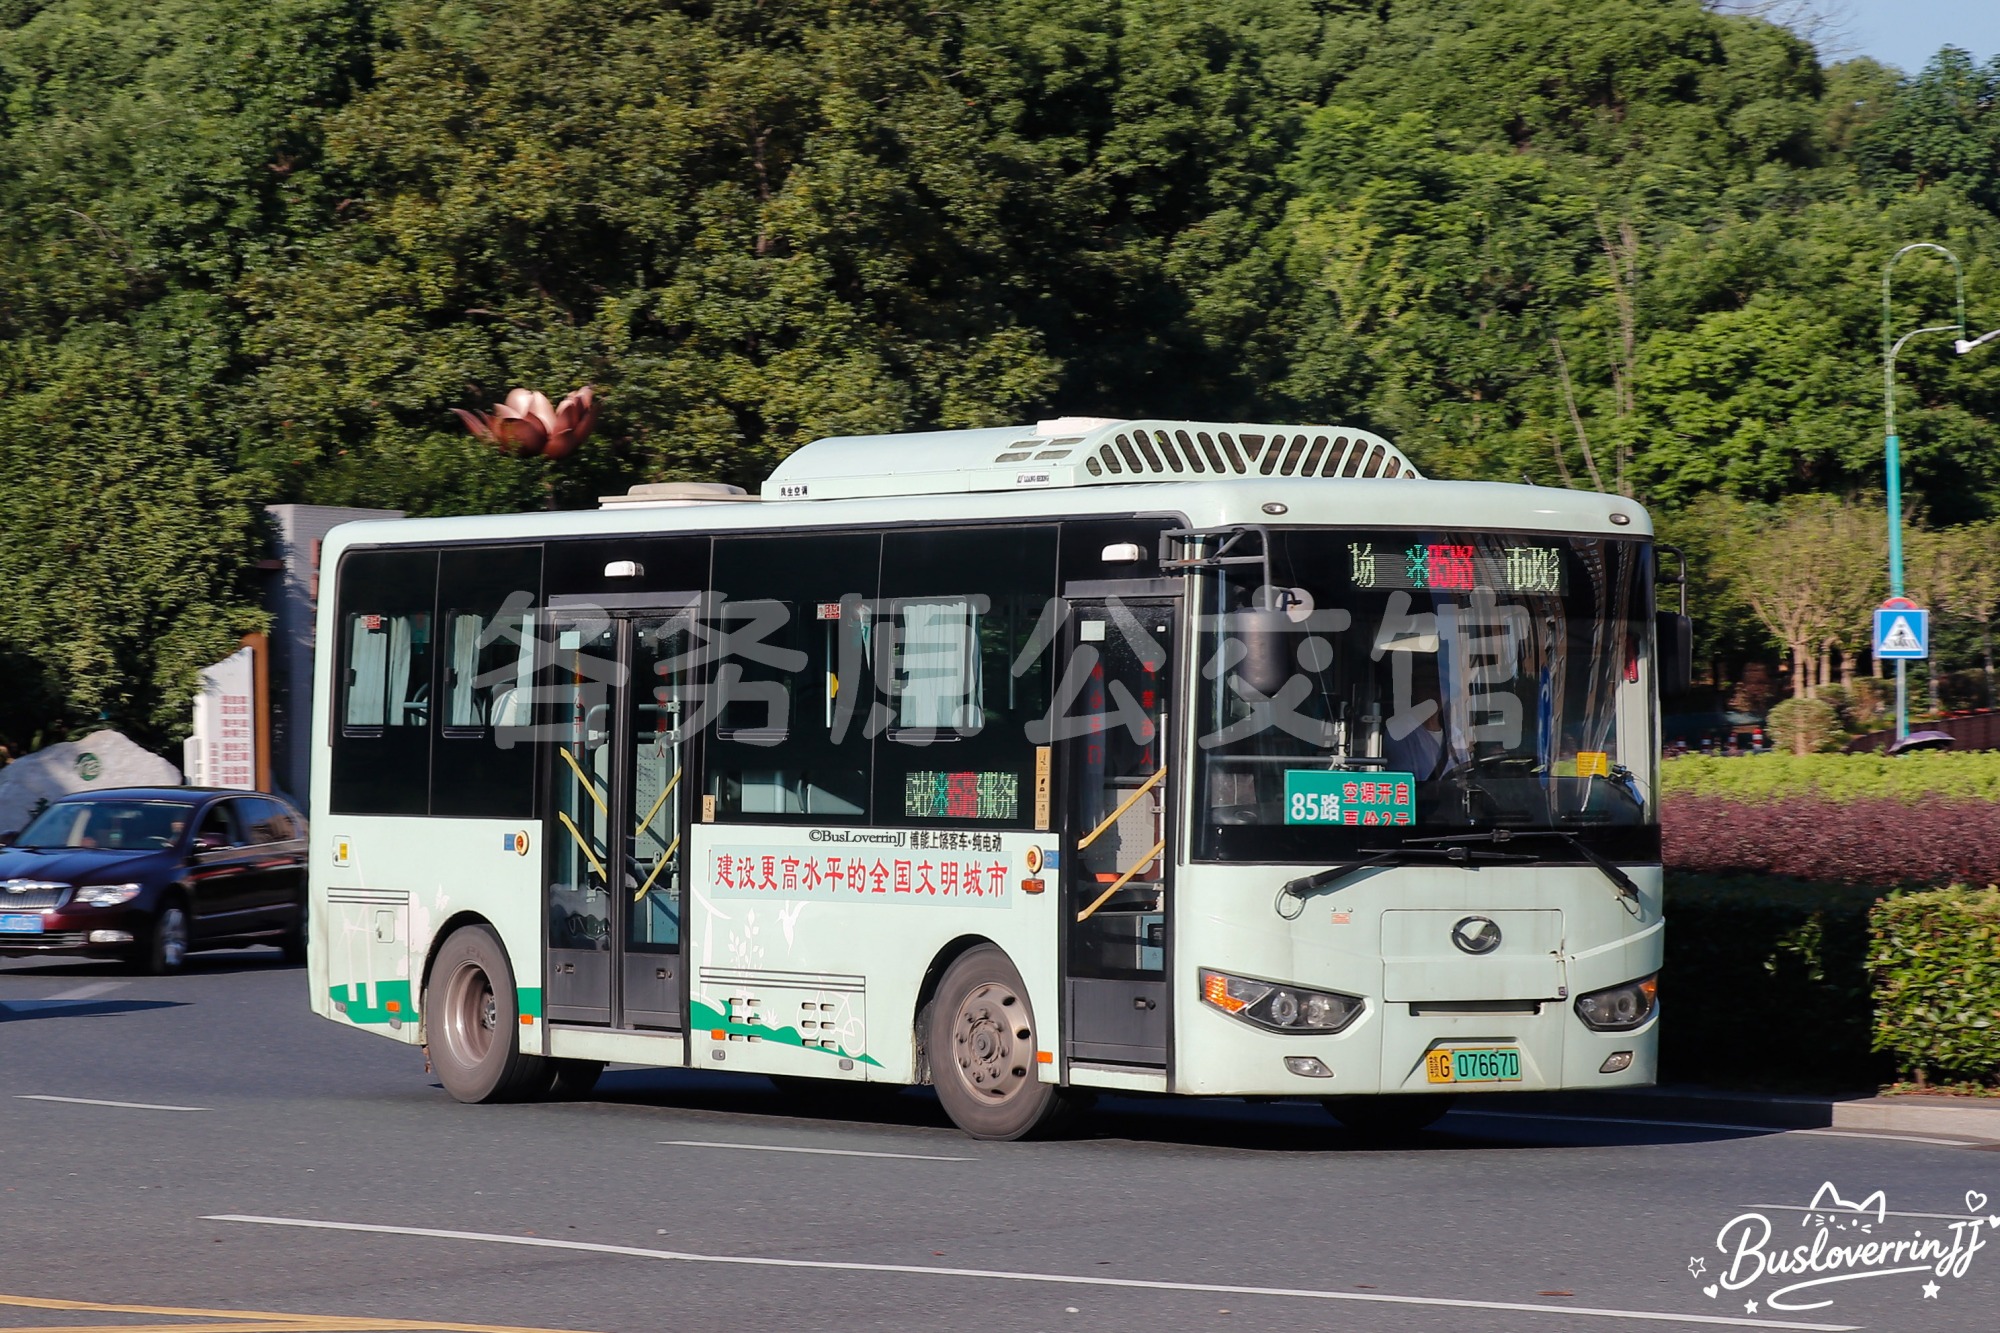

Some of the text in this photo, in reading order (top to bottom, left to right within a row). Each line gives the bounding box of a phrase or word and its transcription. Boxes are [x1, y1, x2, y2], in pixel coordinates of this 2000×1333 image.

[1343, 781, 1410, 805] 空调开启
[1291, 792, 1340, 822] 85路
[714, 852, 1008, 898] 建设更高水平的全国文明城市
[1458, 1053, 1519, 1077] 07667D
